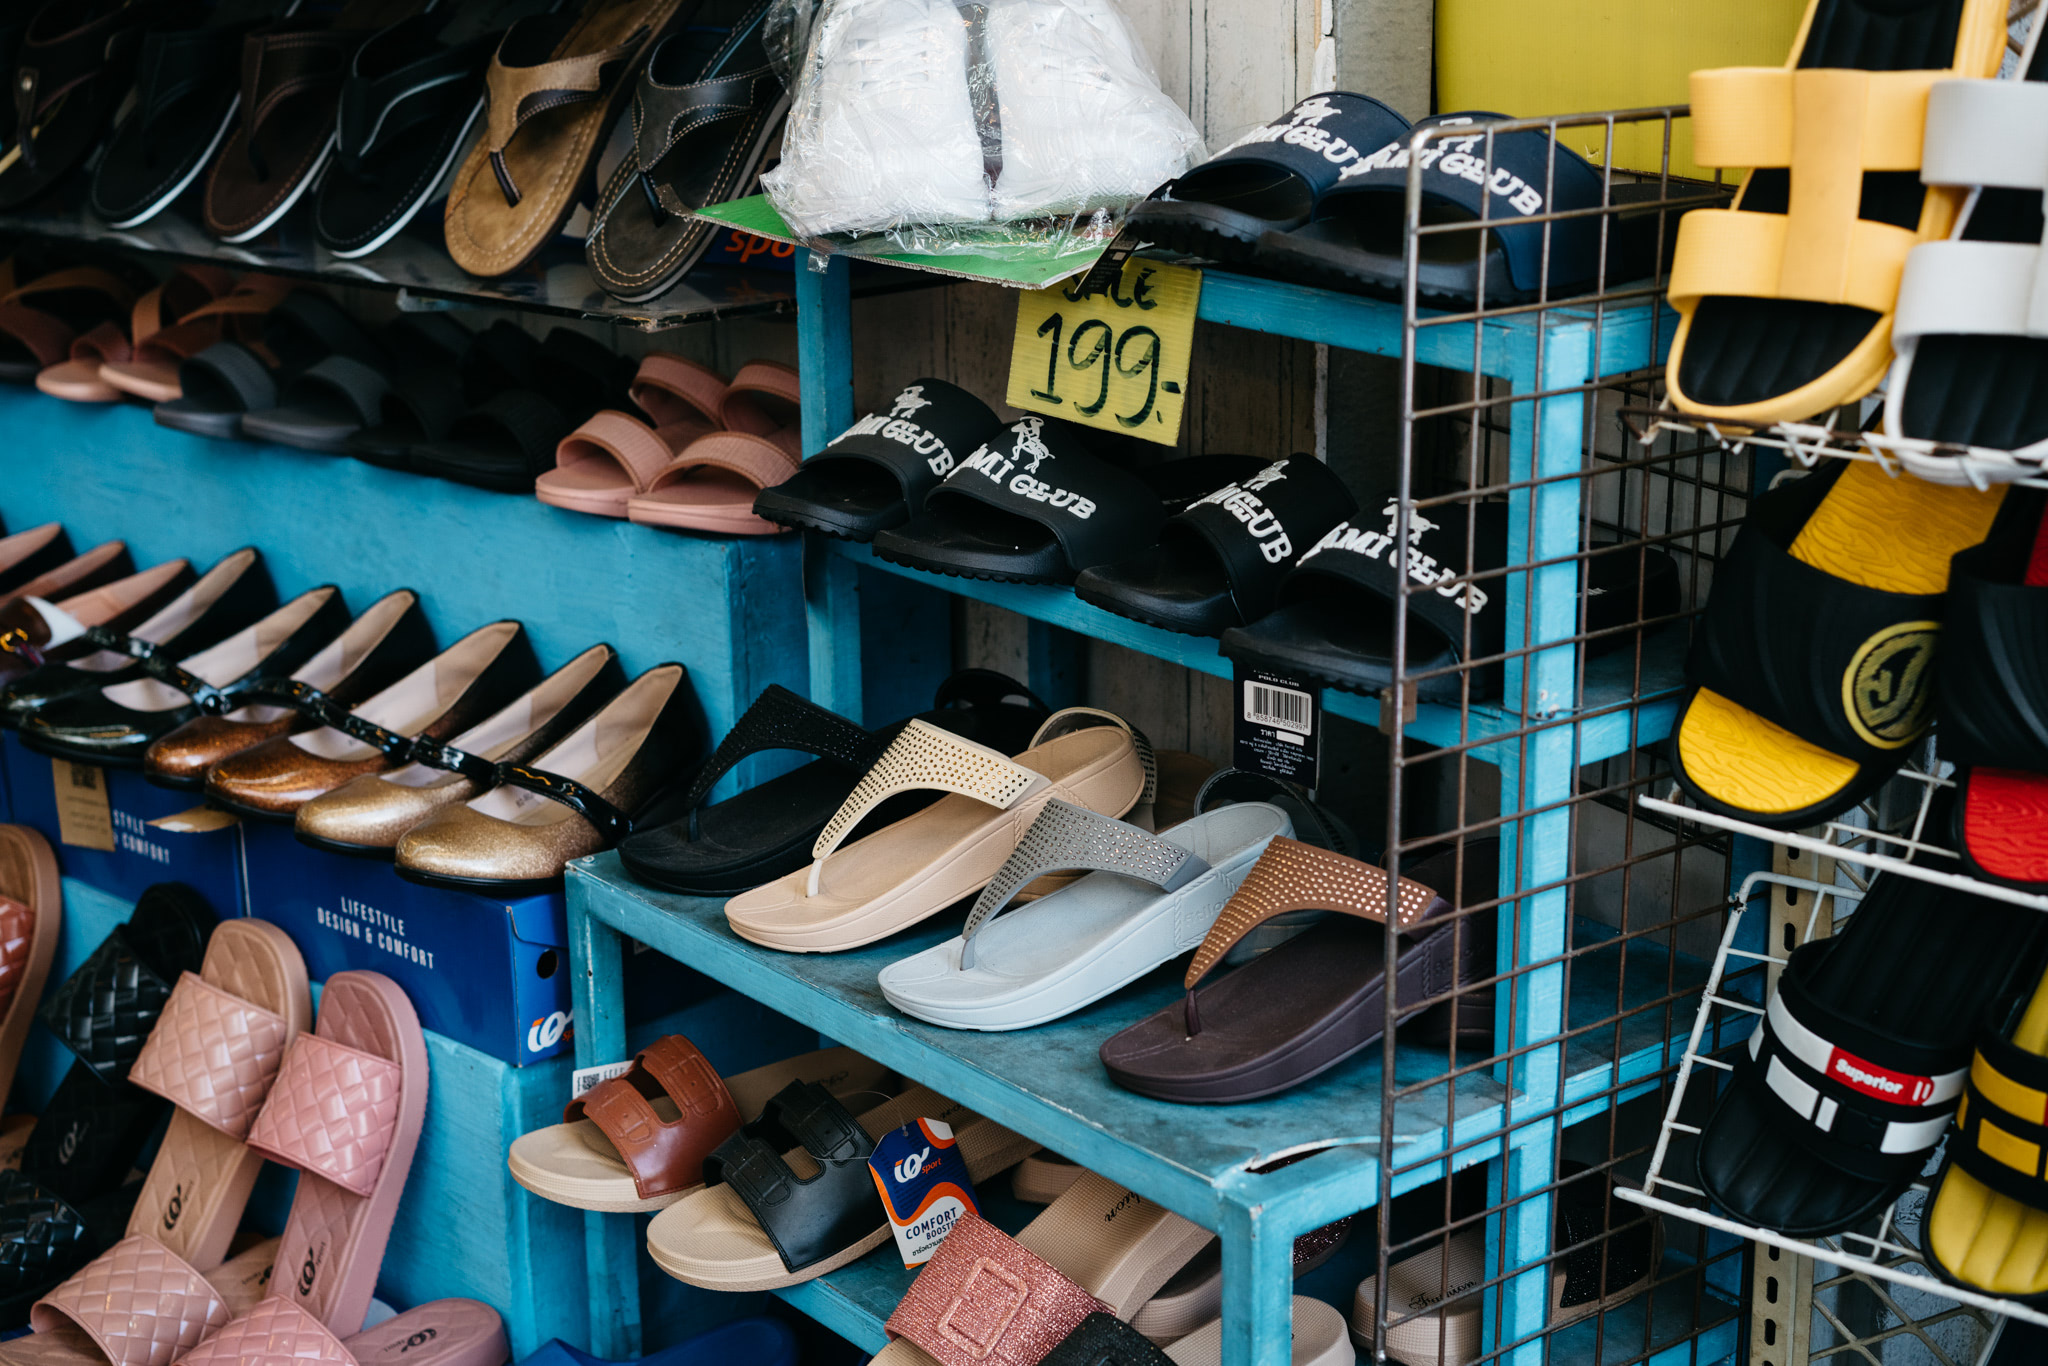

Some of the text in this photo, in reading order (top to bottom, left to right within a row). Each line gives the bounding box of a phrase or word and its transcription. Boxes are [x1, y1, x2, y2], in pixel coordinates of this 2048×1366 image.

[725, 230, 795, 263] spo
[1258, 674, 1279, 683] POLO
[1279, 678, 1300, 687] CLUB
[1255, 713, 1281, 725] 858746
[1282, 718, 1306, 731] 502997
[113, 809, 146, 836] STYLE
[122, 832, 170, 864] COMFORT
[341, 896, 405, 937] LIFESTYLE
[317, 907, 434, 970] DESIGN & COMFORT
[921, 1157, 942, 1175] sport
[905, 1206, 956, 1240] COMFORT
